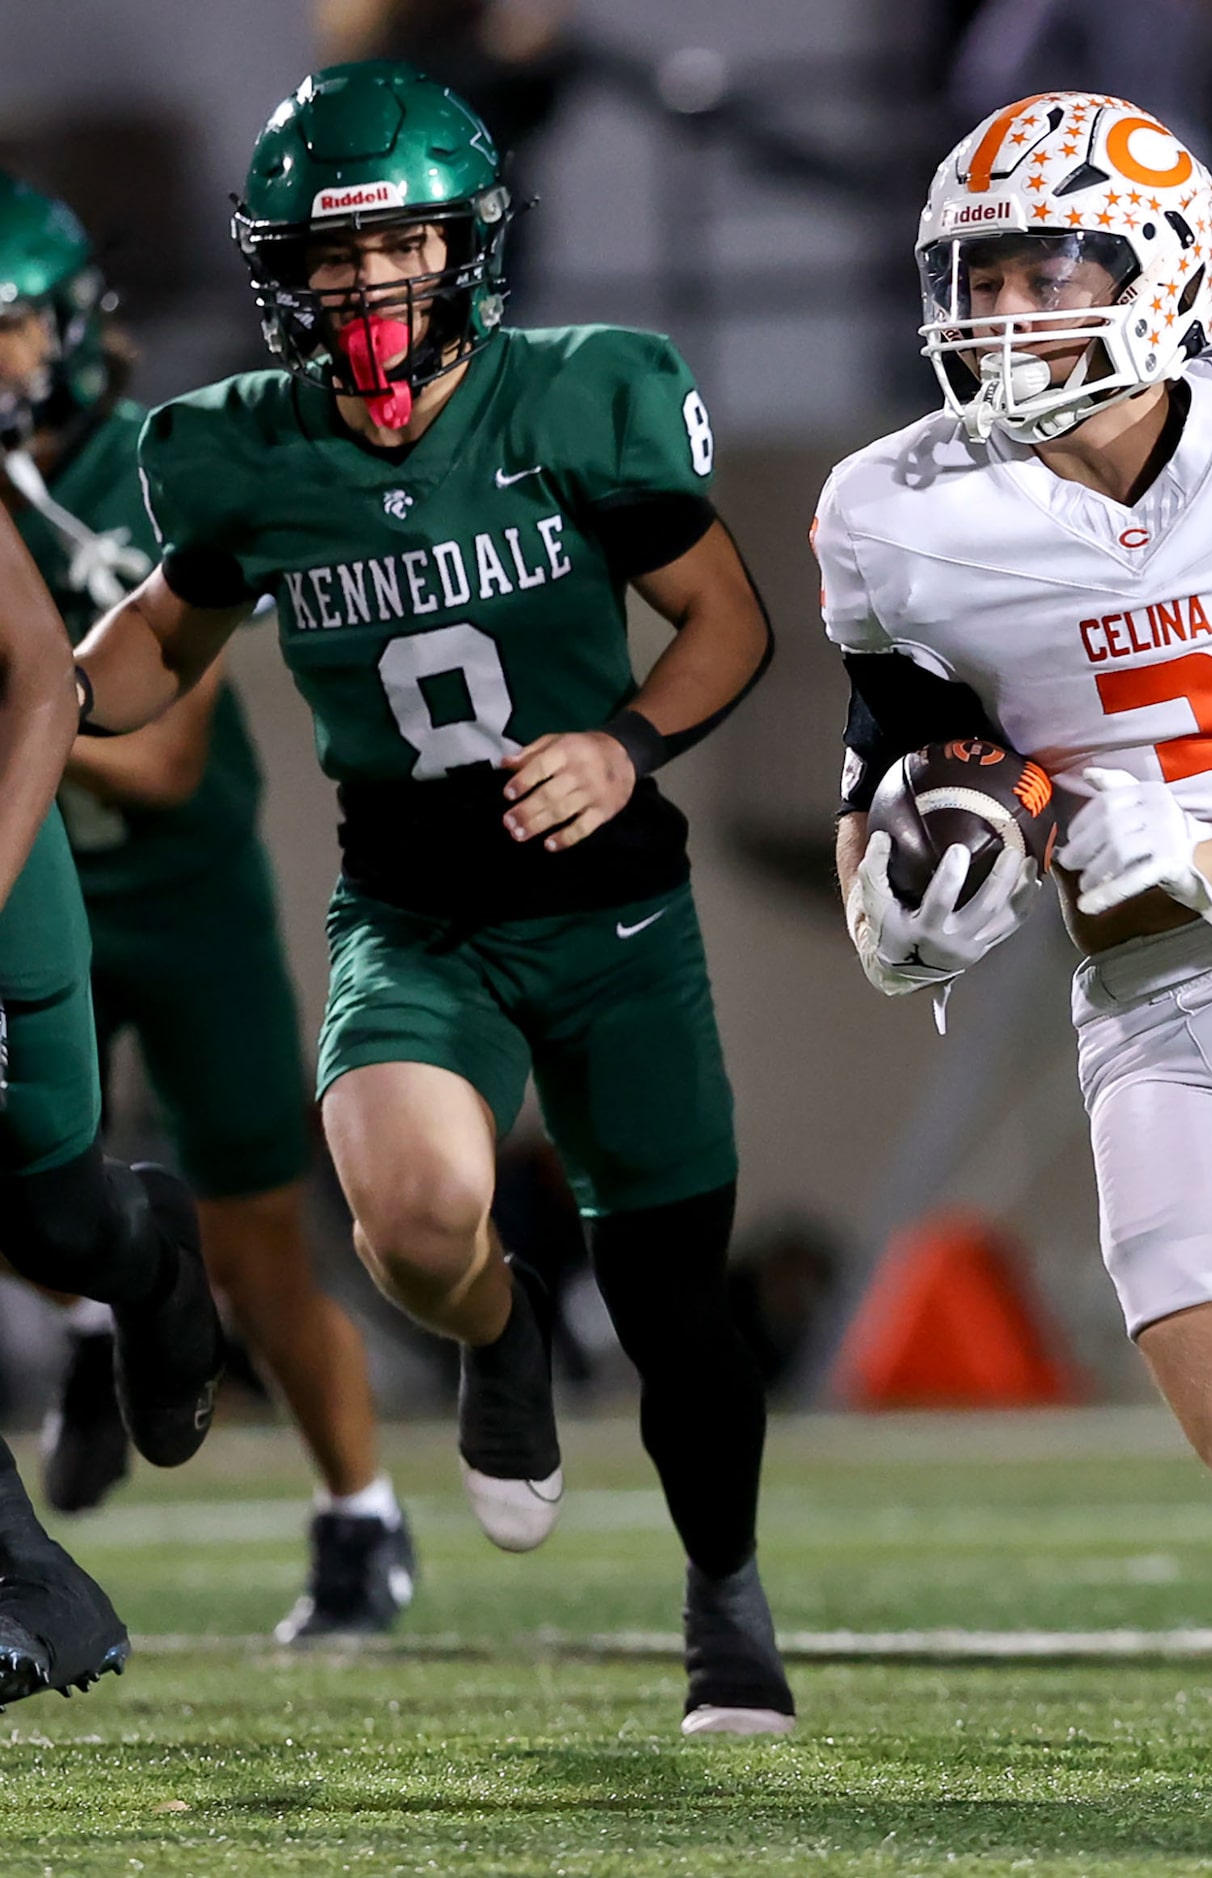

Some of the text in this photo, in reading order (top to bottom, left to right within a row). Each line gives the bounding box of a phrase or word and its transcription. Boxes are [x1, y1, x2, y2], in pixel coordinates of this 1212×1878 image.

[1105, 117, 1193, 188] C
[321, 187, 388, 210] Riddell
[683, 390, 713, 476] 8
[283, 514, 573, 630] KENNEDALE
[1119, 528, 1149, 548] C
[377, 622, 525, 782] 8
